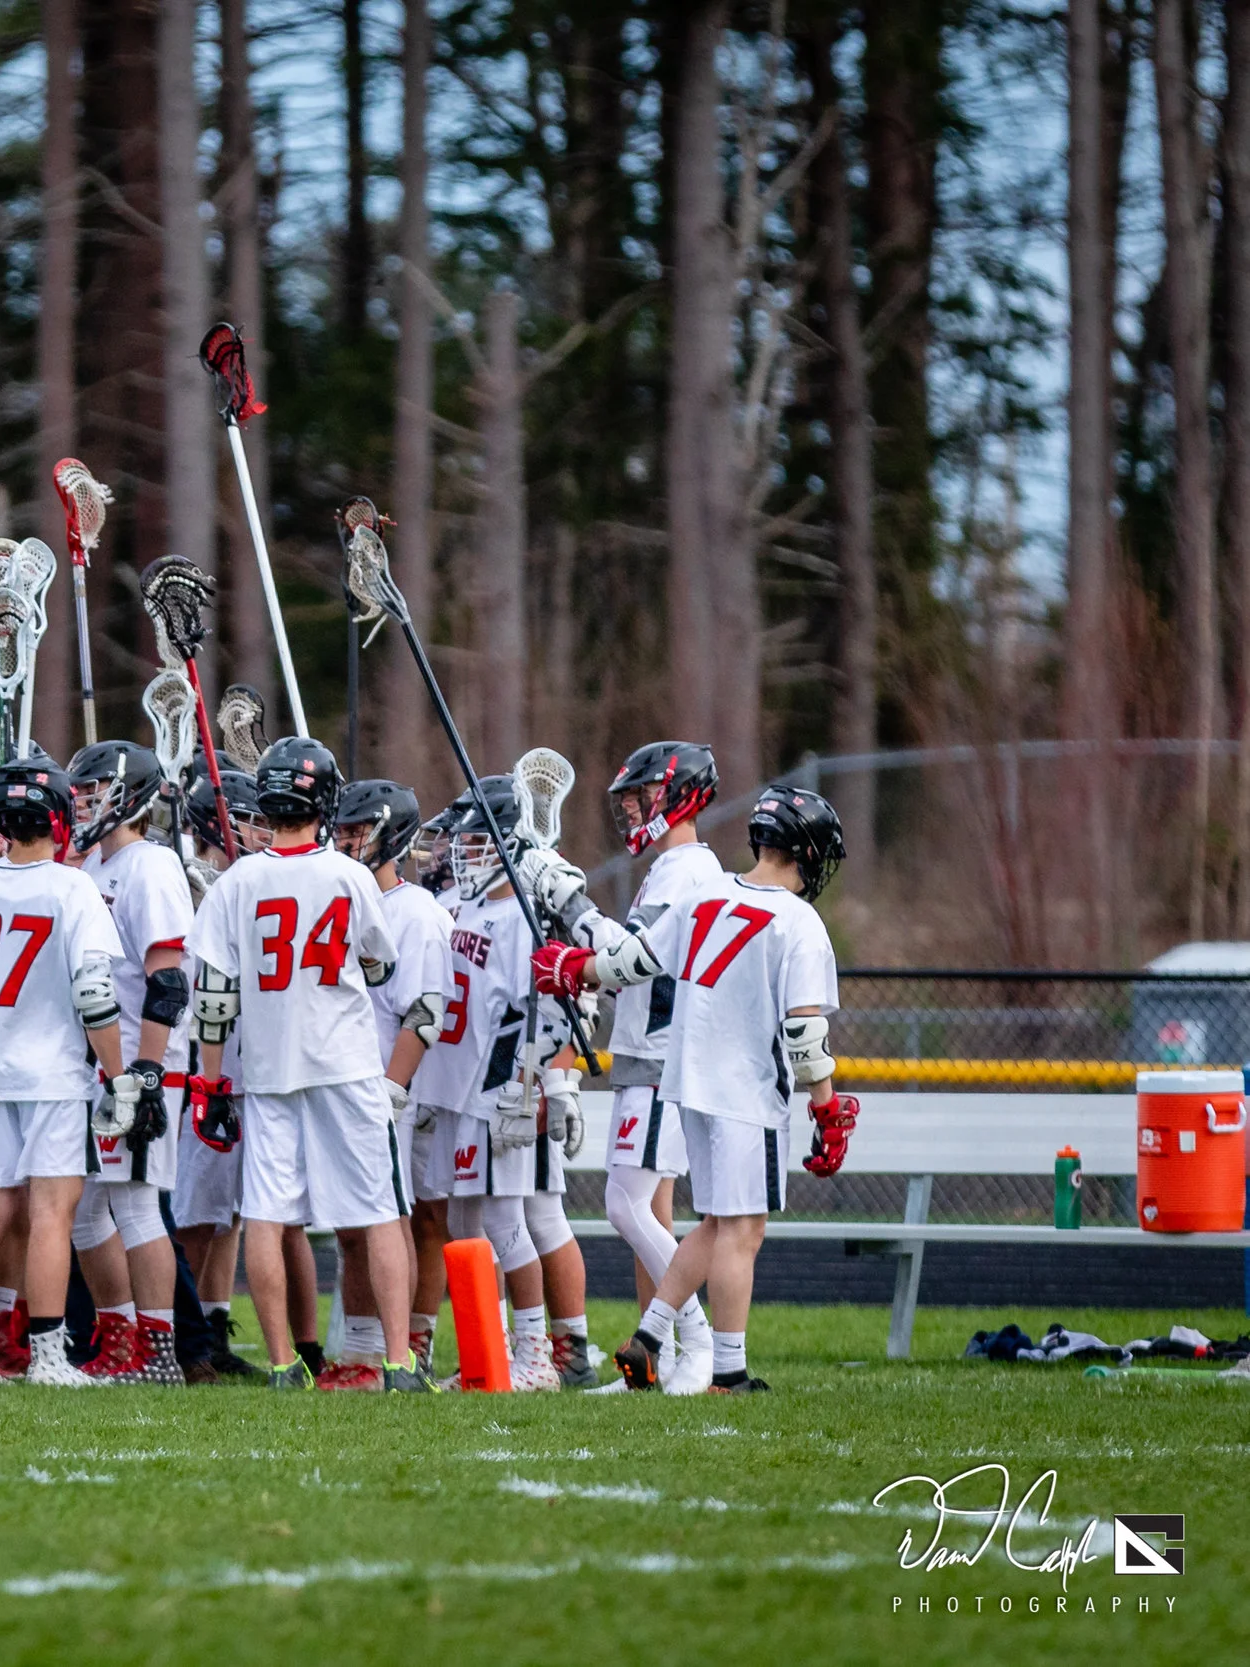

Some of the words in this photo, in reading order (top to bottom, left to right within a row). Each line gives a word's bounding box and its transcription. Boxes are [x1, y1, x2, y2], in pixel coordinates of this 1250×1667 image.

[255, 896, 352, 992] 34
[680, 898, 776, 989] 17
[788, 1049, 810, 1061] STX
